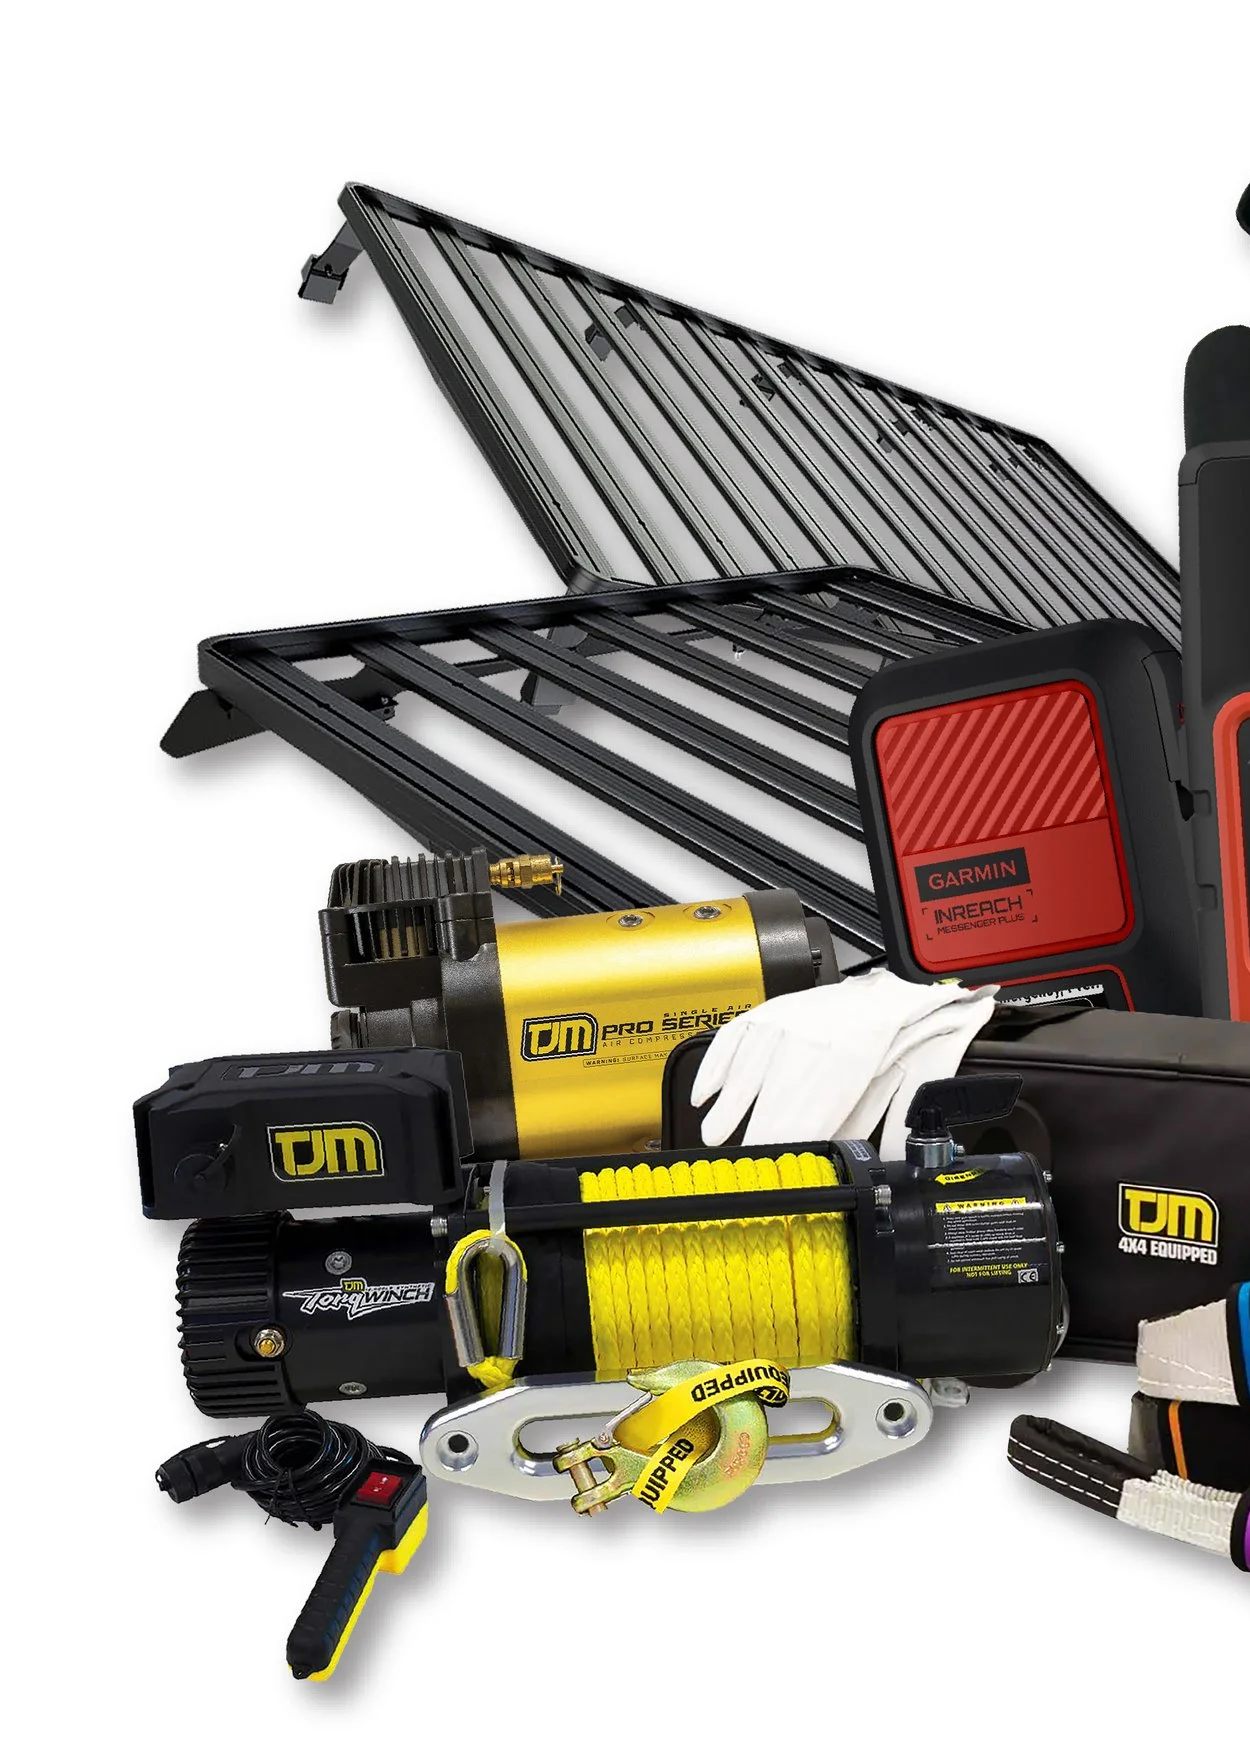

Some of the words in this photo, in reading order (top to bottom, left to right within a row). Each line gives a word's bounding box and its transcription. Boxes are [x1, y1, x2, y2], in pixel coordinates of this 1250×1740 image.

[929, 860, 1017, 890] GARMIN
[935, 896, 1023, 924] INREACH
[938, 918, 997, 935] MESSENGER
[998, 913, 1025, 925] PLUS
[602, 1021, 654, 1040] PRO
[662, 1010, 749, 1031] SERIE
[664, 1008, 718, 1017] SINGLE
[528, 1019, 592, 1055] TJM
[603, 1040, 622, 1048] AIR
[275, 1128, 377, 1176] TJM
[957, 1201, 1005, 1209] WARNING
[1125, 1189, 1213, 1242] TJM
[1150, 1240, 1217, 1265] EQUIPPED
